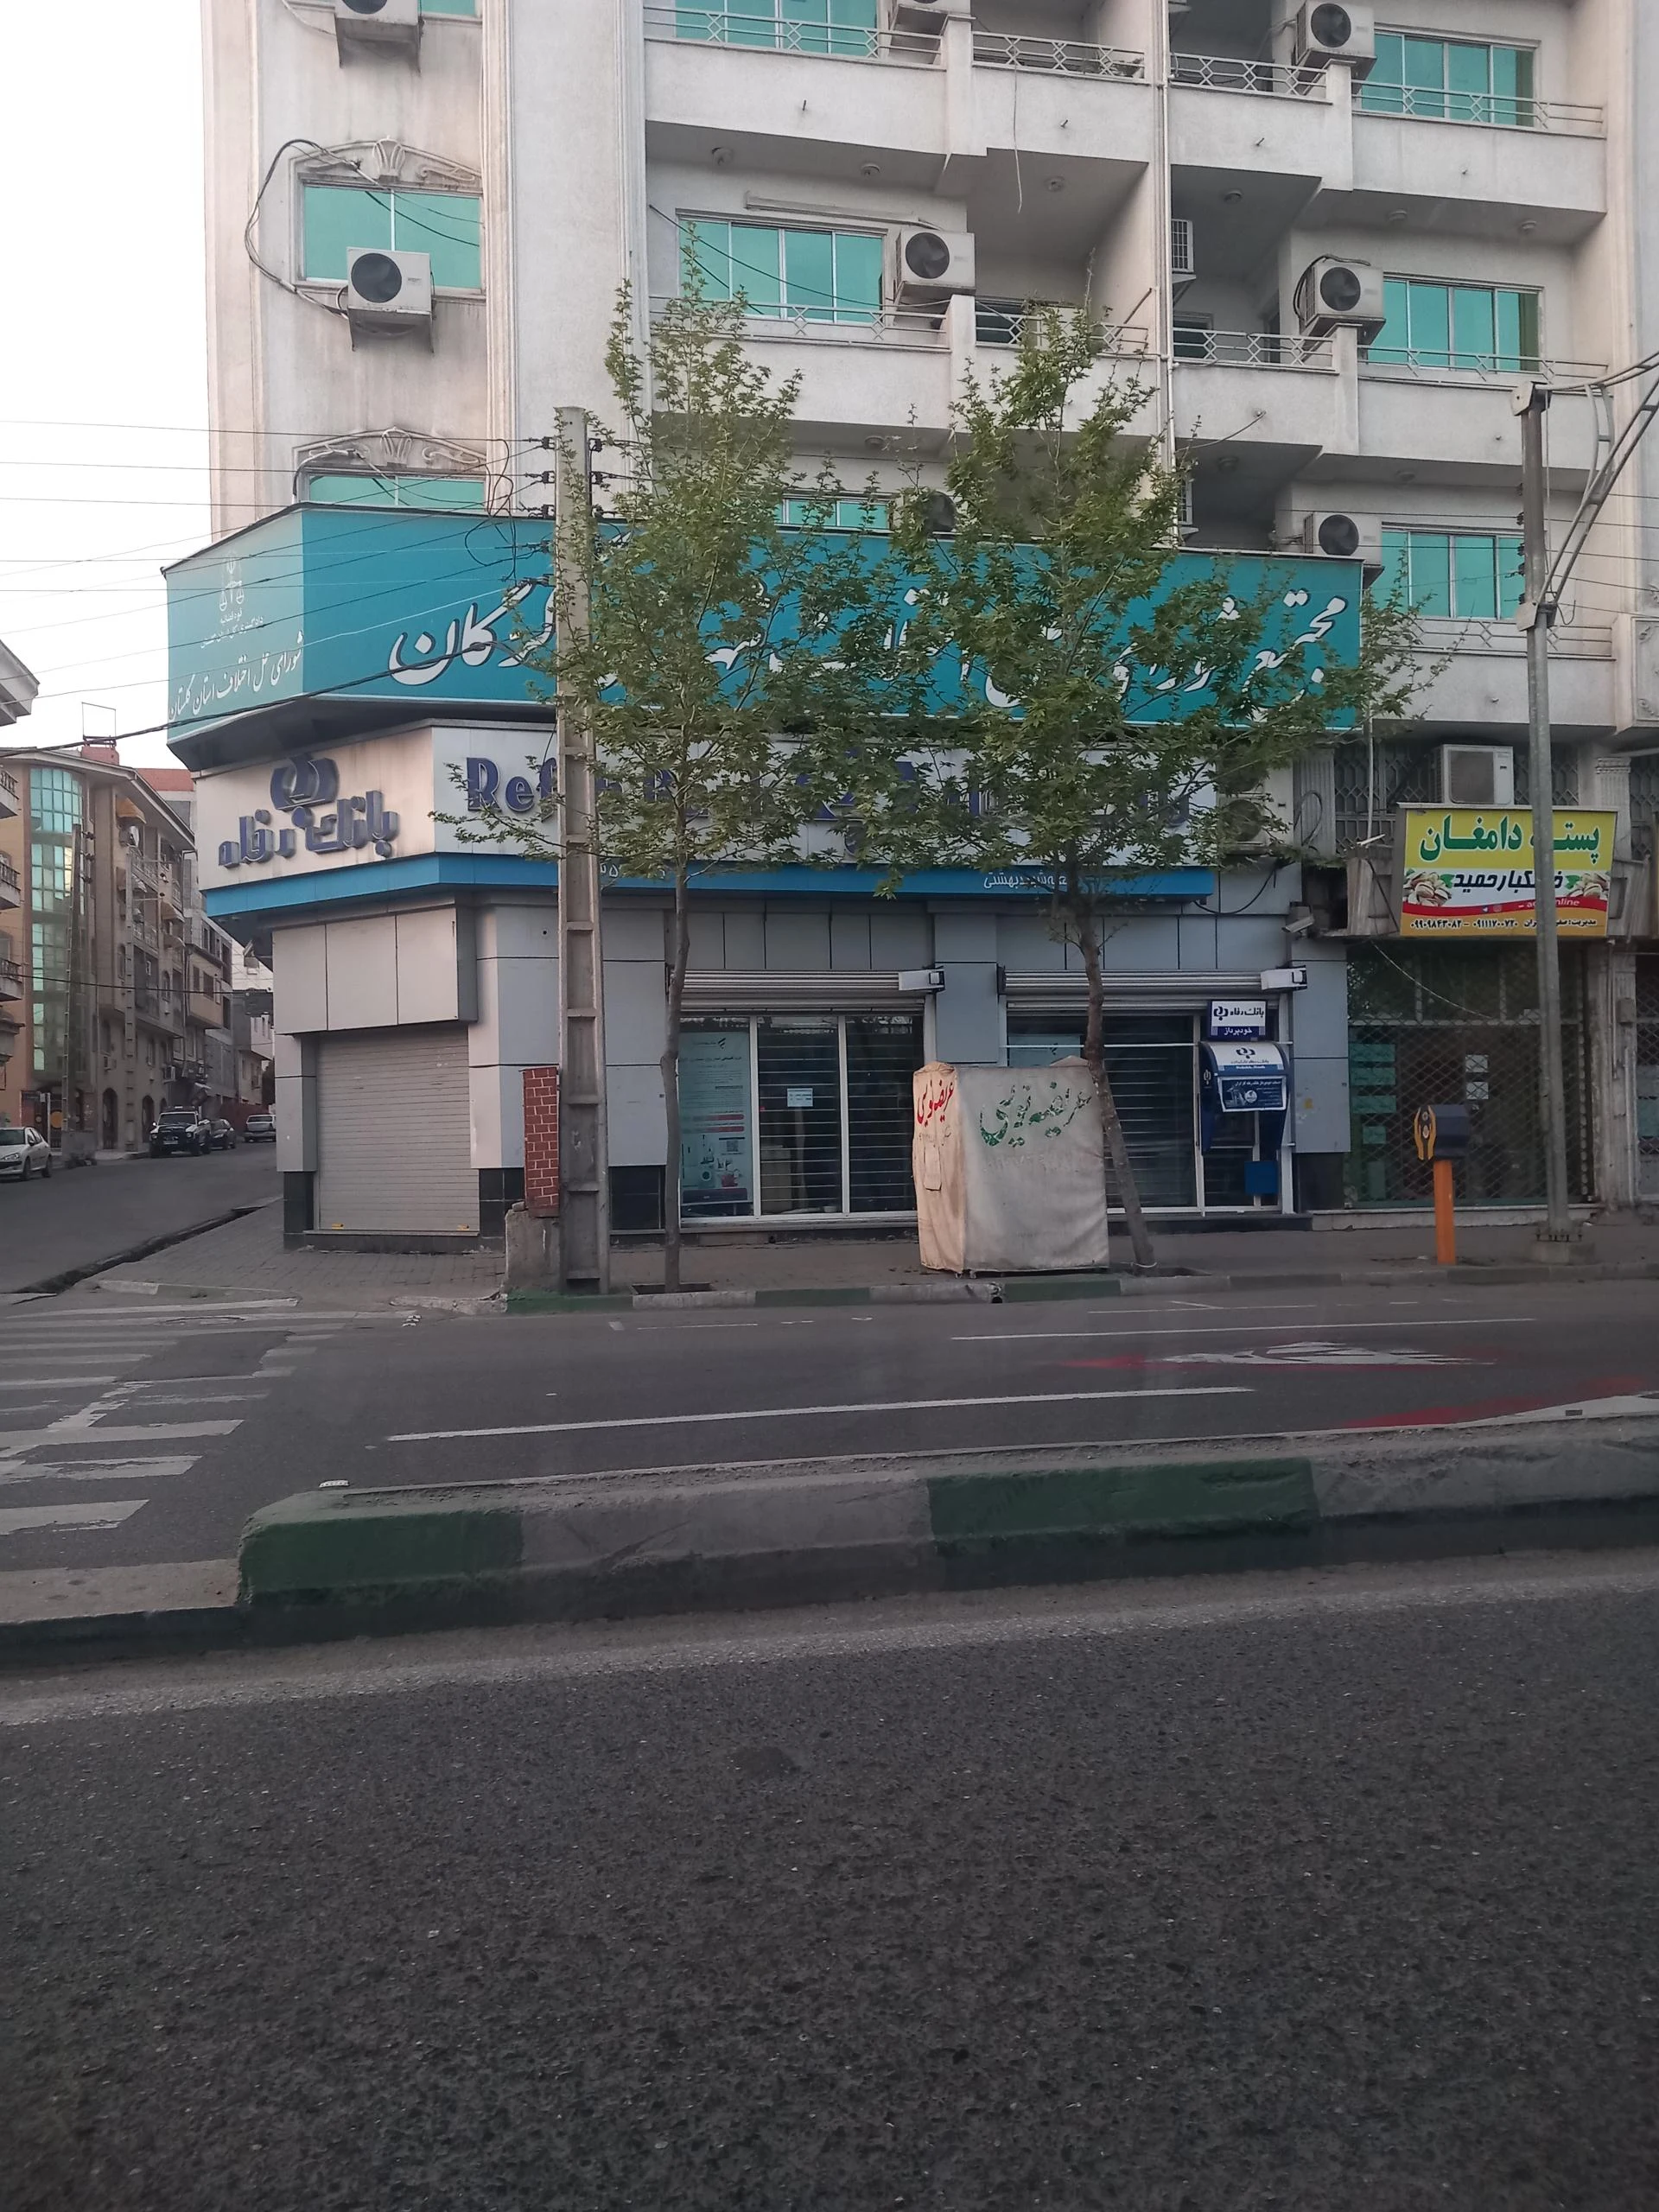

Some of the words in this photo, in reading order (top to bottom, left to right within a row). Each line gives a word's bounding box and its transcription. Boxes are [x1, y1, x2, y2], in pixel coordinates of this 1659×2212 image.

[216, 653, 251, 699] اختلاف
[270, 629, 304, 686] شورای
[192, 675, 215, 715] استان
[305, 790, 400, 858] بانک
[1420, 814, 1522, 862] دامغان
[1529, 822, 1600, 865] پست
[1224, 1027, 1253, 1036] خودپرداز
[1230, 1007, 1244, 1016] رفاه
[1243, 1007, 1265, 1019] بانک
